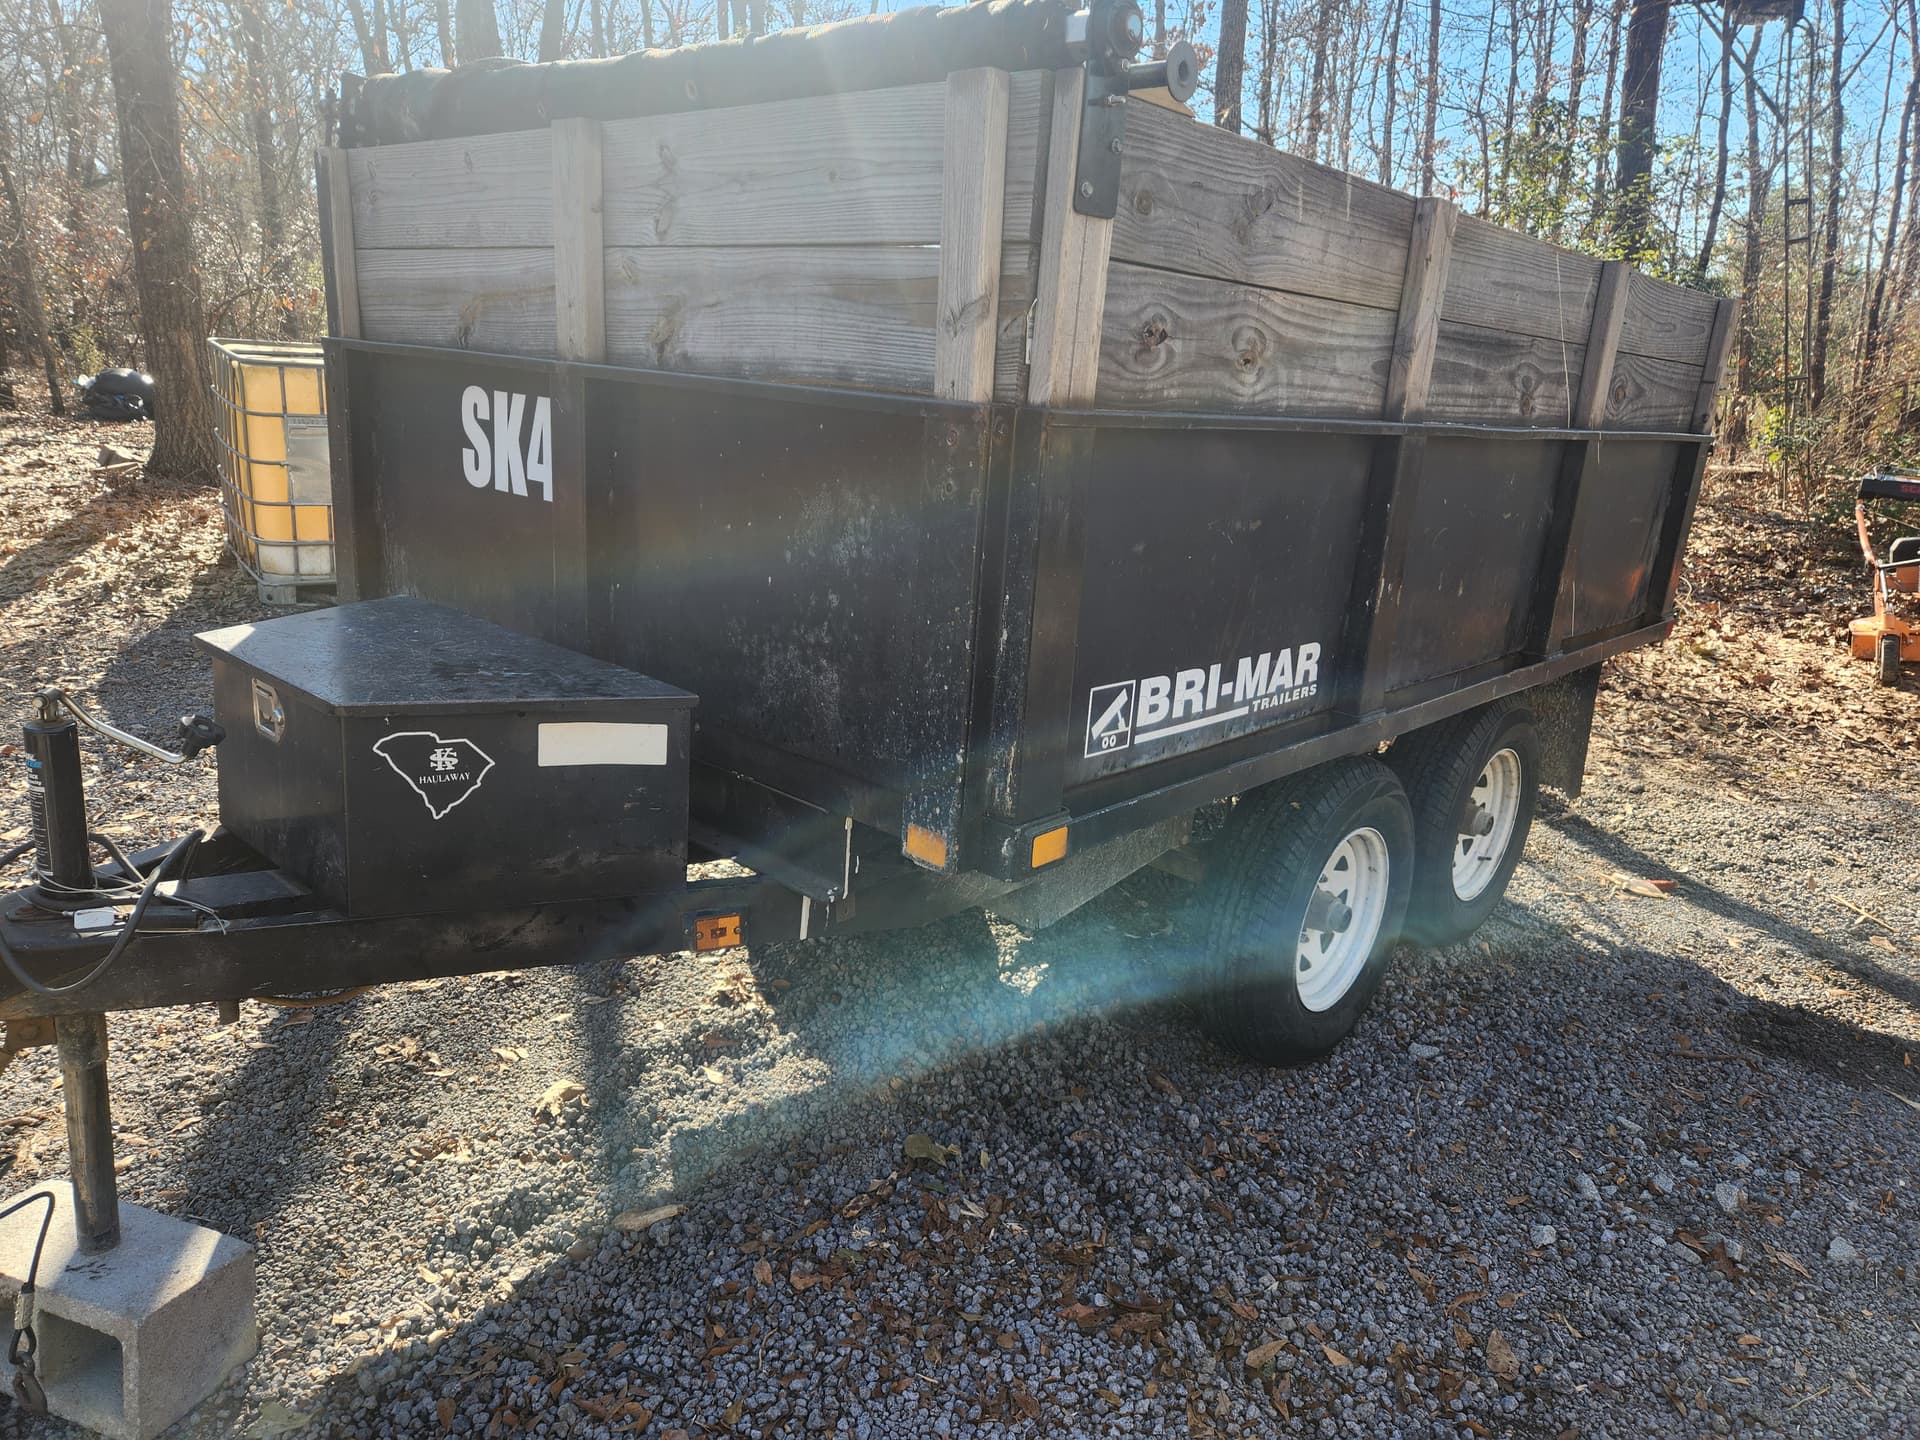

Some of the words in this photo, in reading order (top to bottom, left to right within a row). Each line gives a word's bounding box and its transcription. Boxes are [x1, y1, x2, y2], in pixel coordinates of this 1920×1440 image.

[461, 385, 553, 503] SK4
[1136, 642, 1321, 727] BRI-MAR
[1252, 684, 1317, 712] TRAILERS
[419, 771, 471, 784] HAULAWAY
